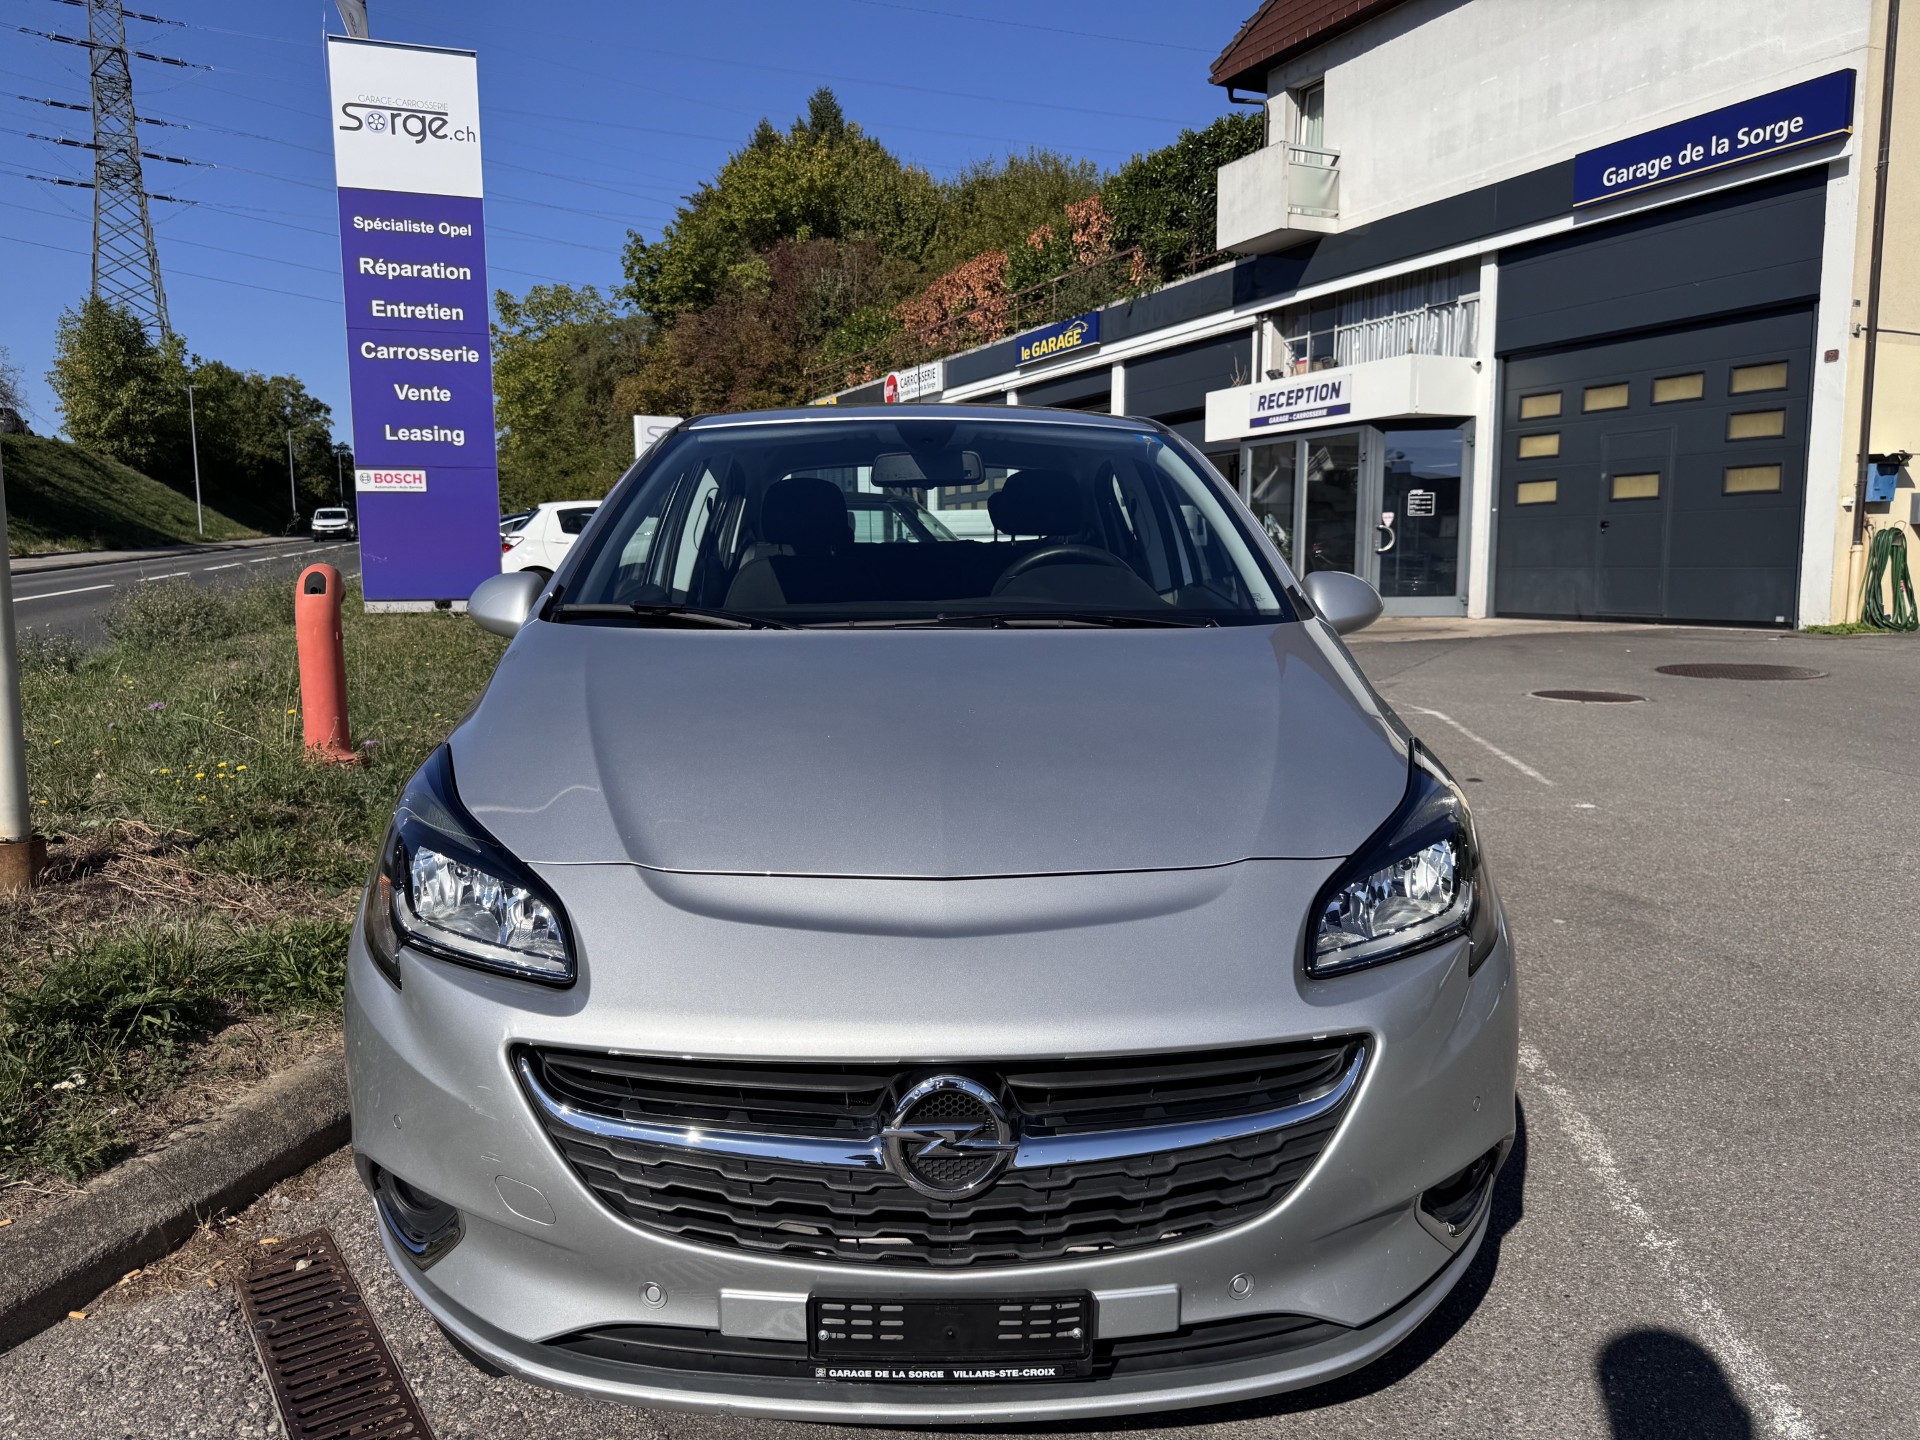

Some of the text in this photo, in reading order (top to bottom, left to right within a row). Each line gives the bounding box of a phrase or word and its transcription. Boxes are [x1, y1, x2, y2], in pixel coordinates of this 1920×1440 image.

[358, 94, 448, 111] GARAGE-CARROSSERIE
[1602, 116, 1804, 187] Garage de la Sorge
[353, 216, 472, 238] Spécialiste Opel
[359, 257, 471, 280] Réparation
[371, 299, 464, 321] Entretien
[360, 341, 479, 363] Carrosserie
[1021, 328, 1082, 361] le GARAGE
[393, 383, 452, 402] Vente
[1257, 381, 1342, 412] RECEPTION
[384, 424, 465, 446] Leasing
[373, 473, 423, 484] BOSCH
[828, 1368, 1055, 1378] GARAGE DE LA SORGE VILLARS-STE-CROIX
